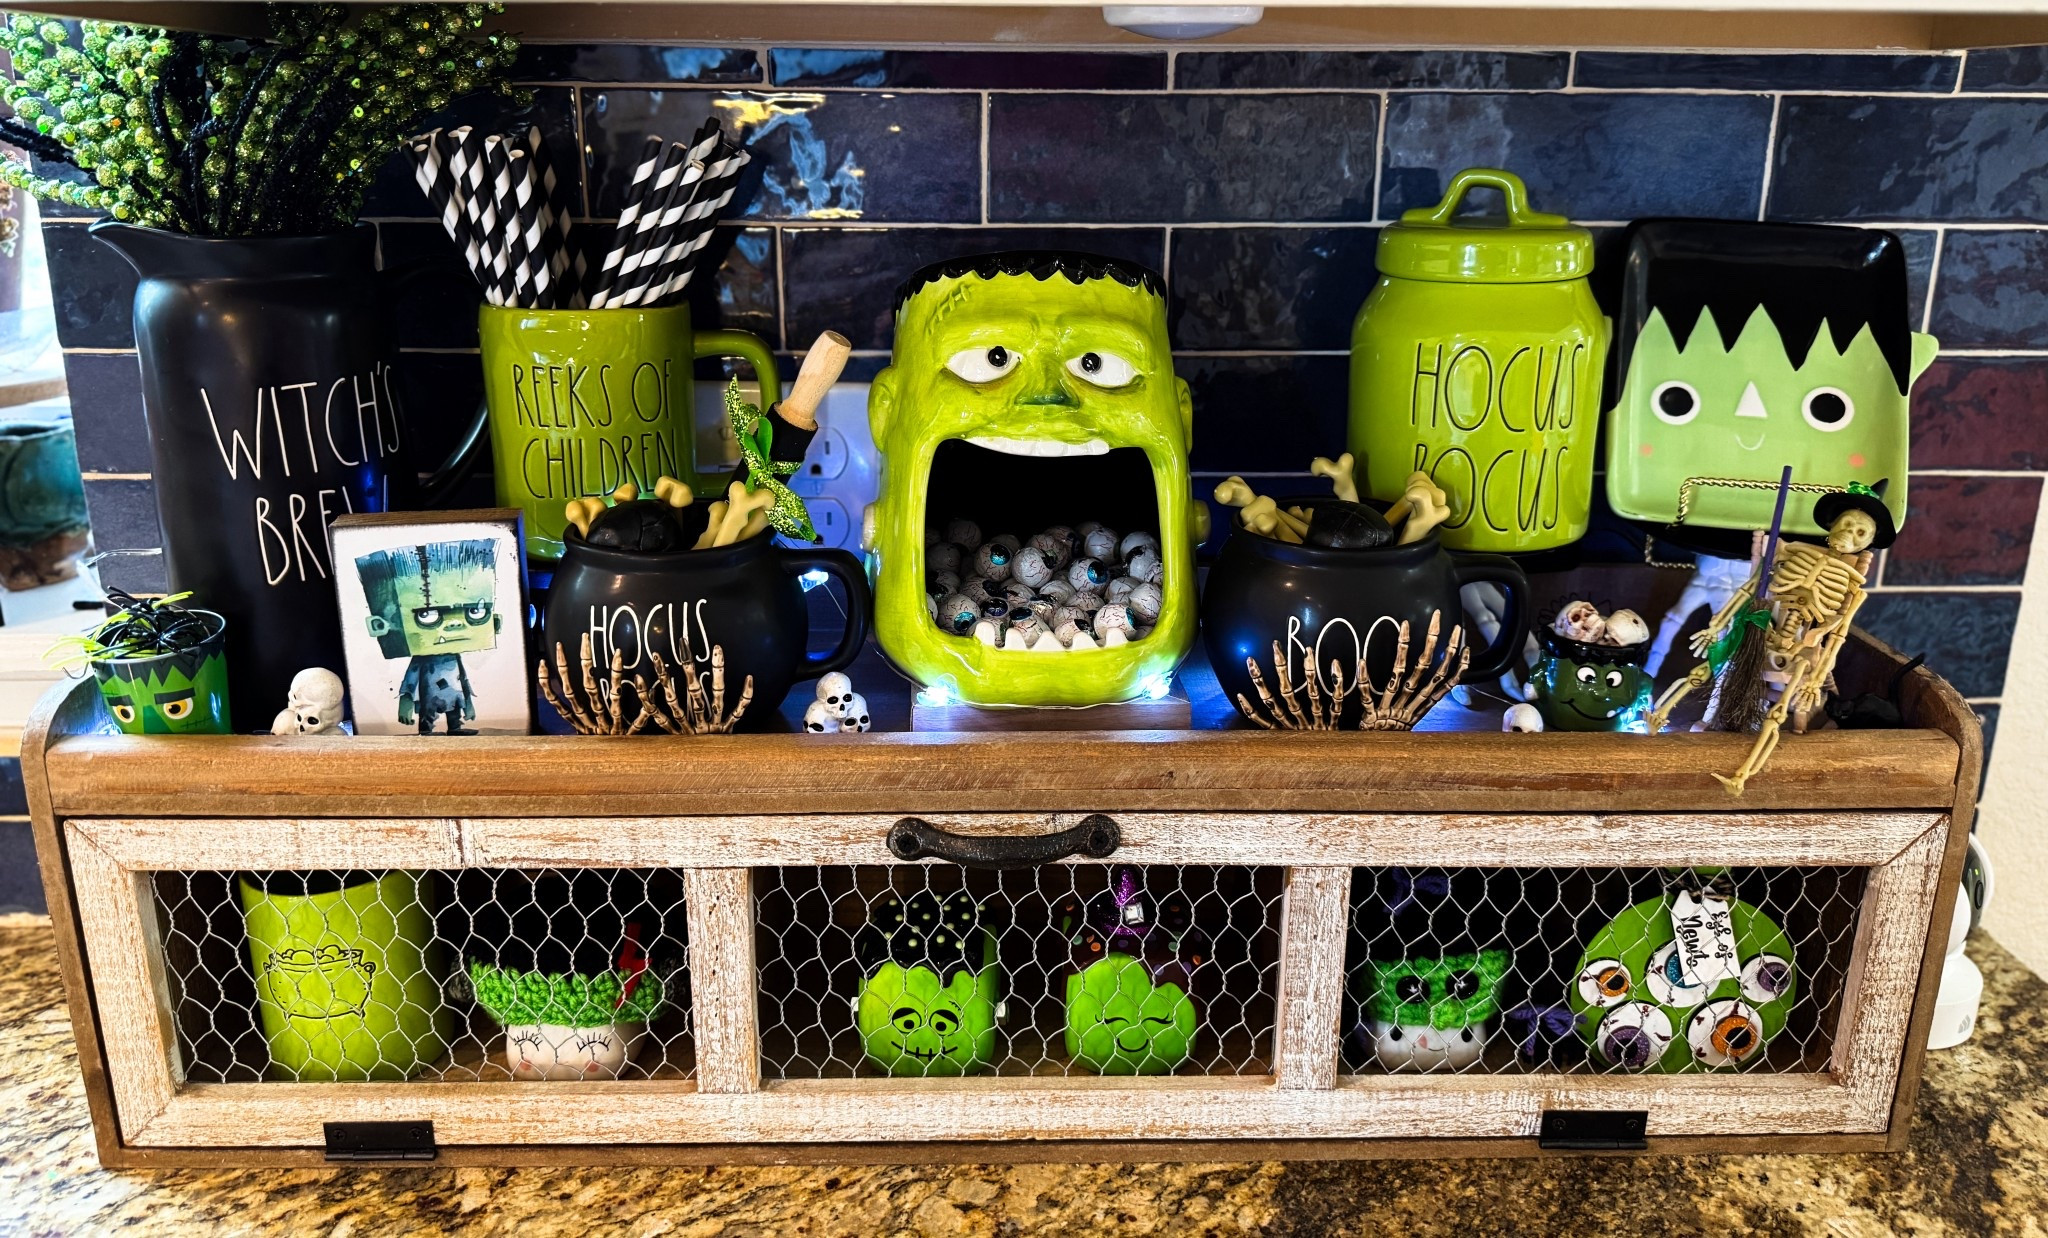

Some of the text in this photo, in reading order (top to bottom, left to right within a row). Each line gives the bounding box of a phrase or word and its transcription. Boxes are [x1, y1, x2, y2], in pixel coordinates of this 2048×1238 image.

[201, 361, 400, 480] WITCH'S
[513, 359, 672, 428] REEKS OF
[1411, 342, 1584, 432] HOCUS
[523, 429, 679, 498] CHILDREN
[256, 474, 389, 586] BRE
[589, 598, 711, 670] HOCUS
